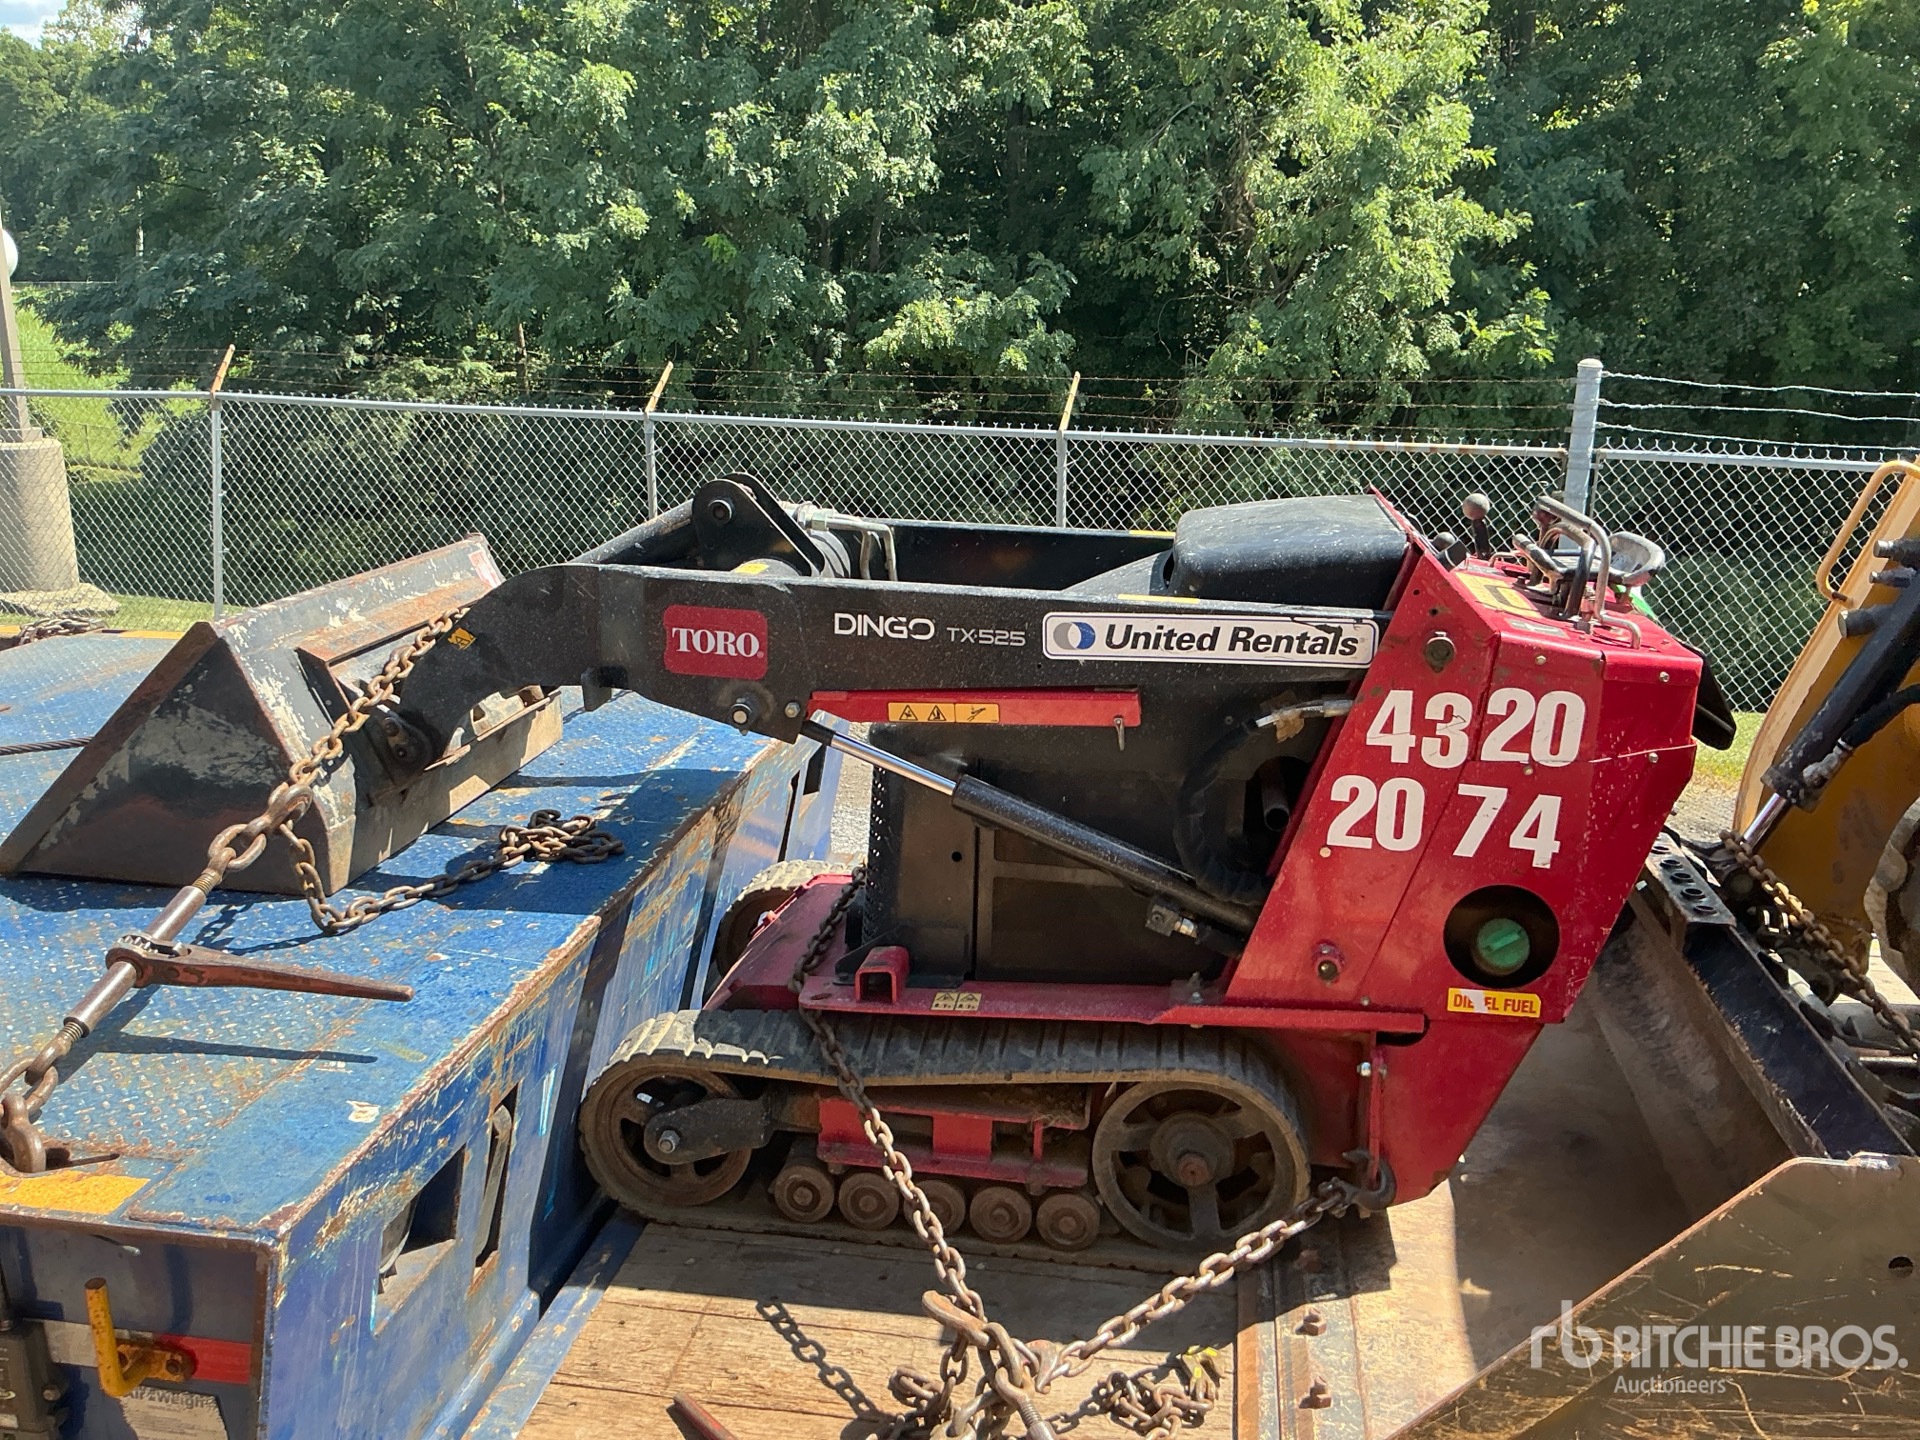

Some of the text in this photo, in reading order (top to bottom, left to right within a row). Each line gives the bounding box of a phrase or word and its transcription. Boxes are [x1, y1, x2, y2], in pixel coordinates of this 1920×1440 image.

[834, 612, 936, 640] DINGO
[1105, 624, 1359, 656] United Rentals
[1453, 993, 1536, 1013] DIEEL FUEL
